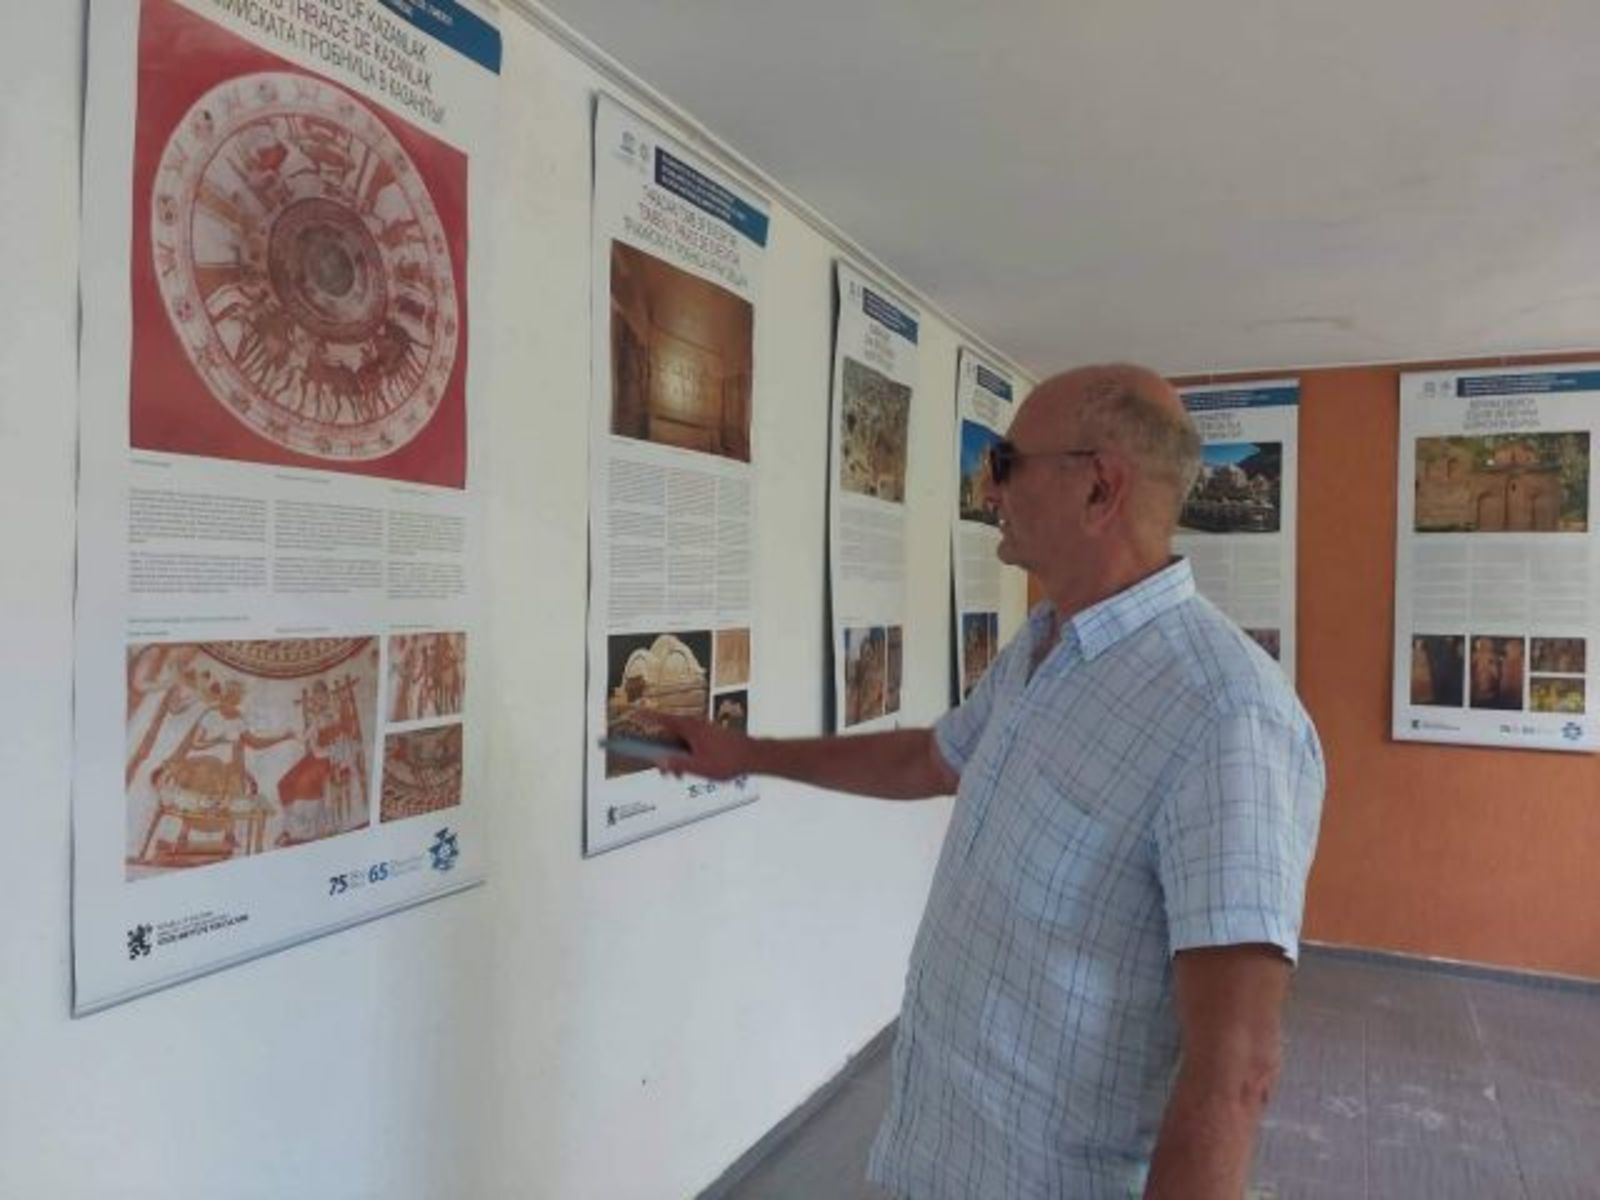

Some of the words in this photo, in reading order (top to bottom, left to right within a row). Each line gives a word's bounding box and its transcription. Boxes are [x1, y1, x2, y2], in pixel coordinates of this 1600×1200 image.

[367, 9, 428, 63] KAZANLAK
[354, 26, 371, 56] DE
[374, 39, 433, 95] KAZANLAK
[329, 874, 349, 896] 75
[368, 861, 390, 884] 65
